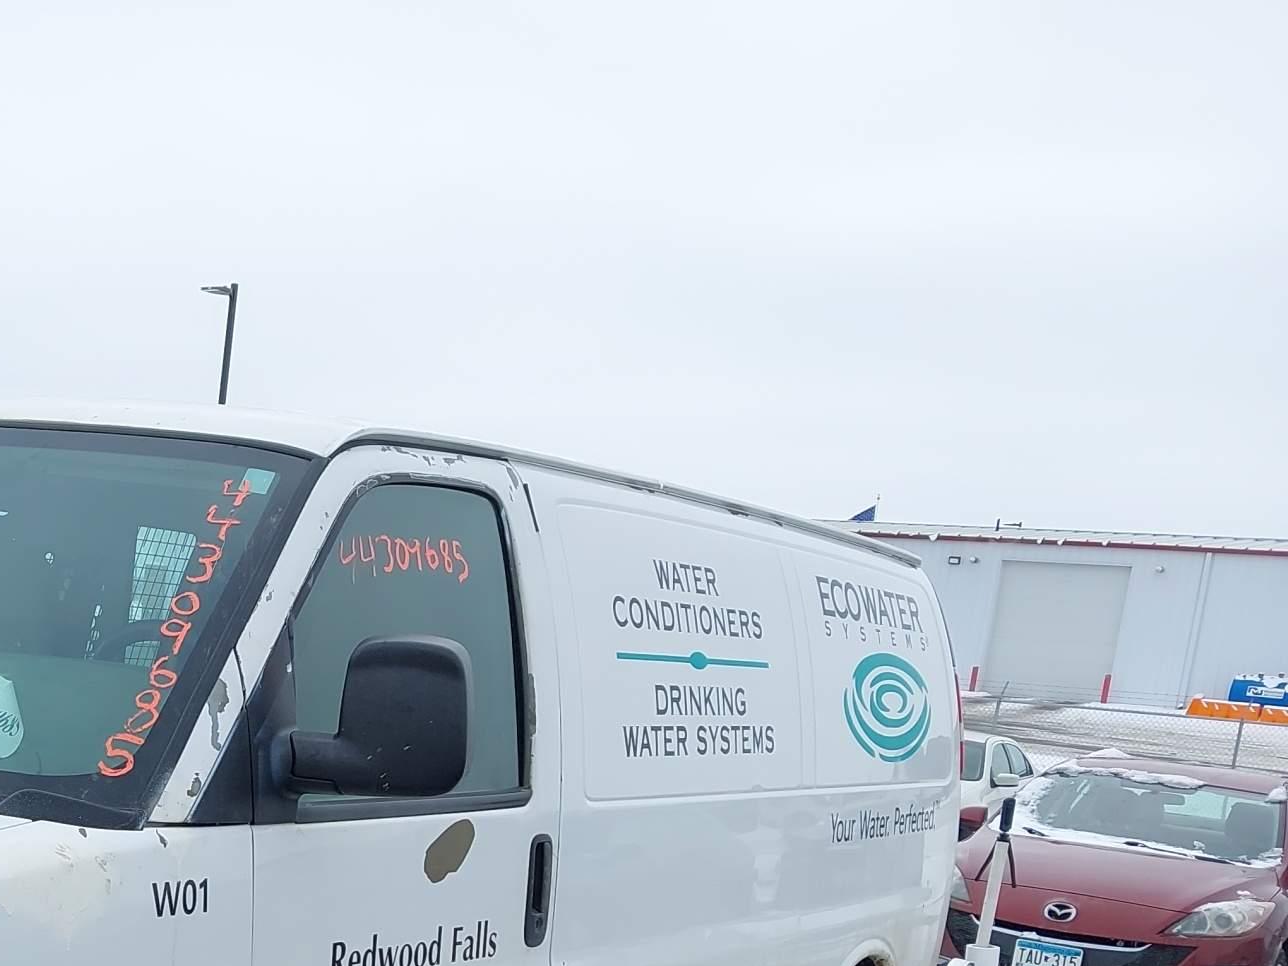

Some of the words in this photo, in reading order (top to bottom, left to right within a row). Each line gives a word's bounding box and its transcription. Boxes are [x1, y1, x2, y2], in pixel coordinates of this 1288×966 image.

[338, 533, 471, 584] 44309685
[653, 559, 720, 597] WATER
[612, 595, 763, 640] CONDITIONERS
[815, 575, 925, 634] ECOWATER
[98, 478, 253, 778] 44309685
[654, 684, 747, 717] DRINKING
[623, 725, 689, 758] WATER
[697, 725, 776, 756] SYSTEMS
[830, 812, 857, 843] Your
[859, 809, 890, 840] Water.
[151, 877, 210, 918] W01
[451, 919, 498, 964] Falls
[1018, 947, 1044, 966] TAU
